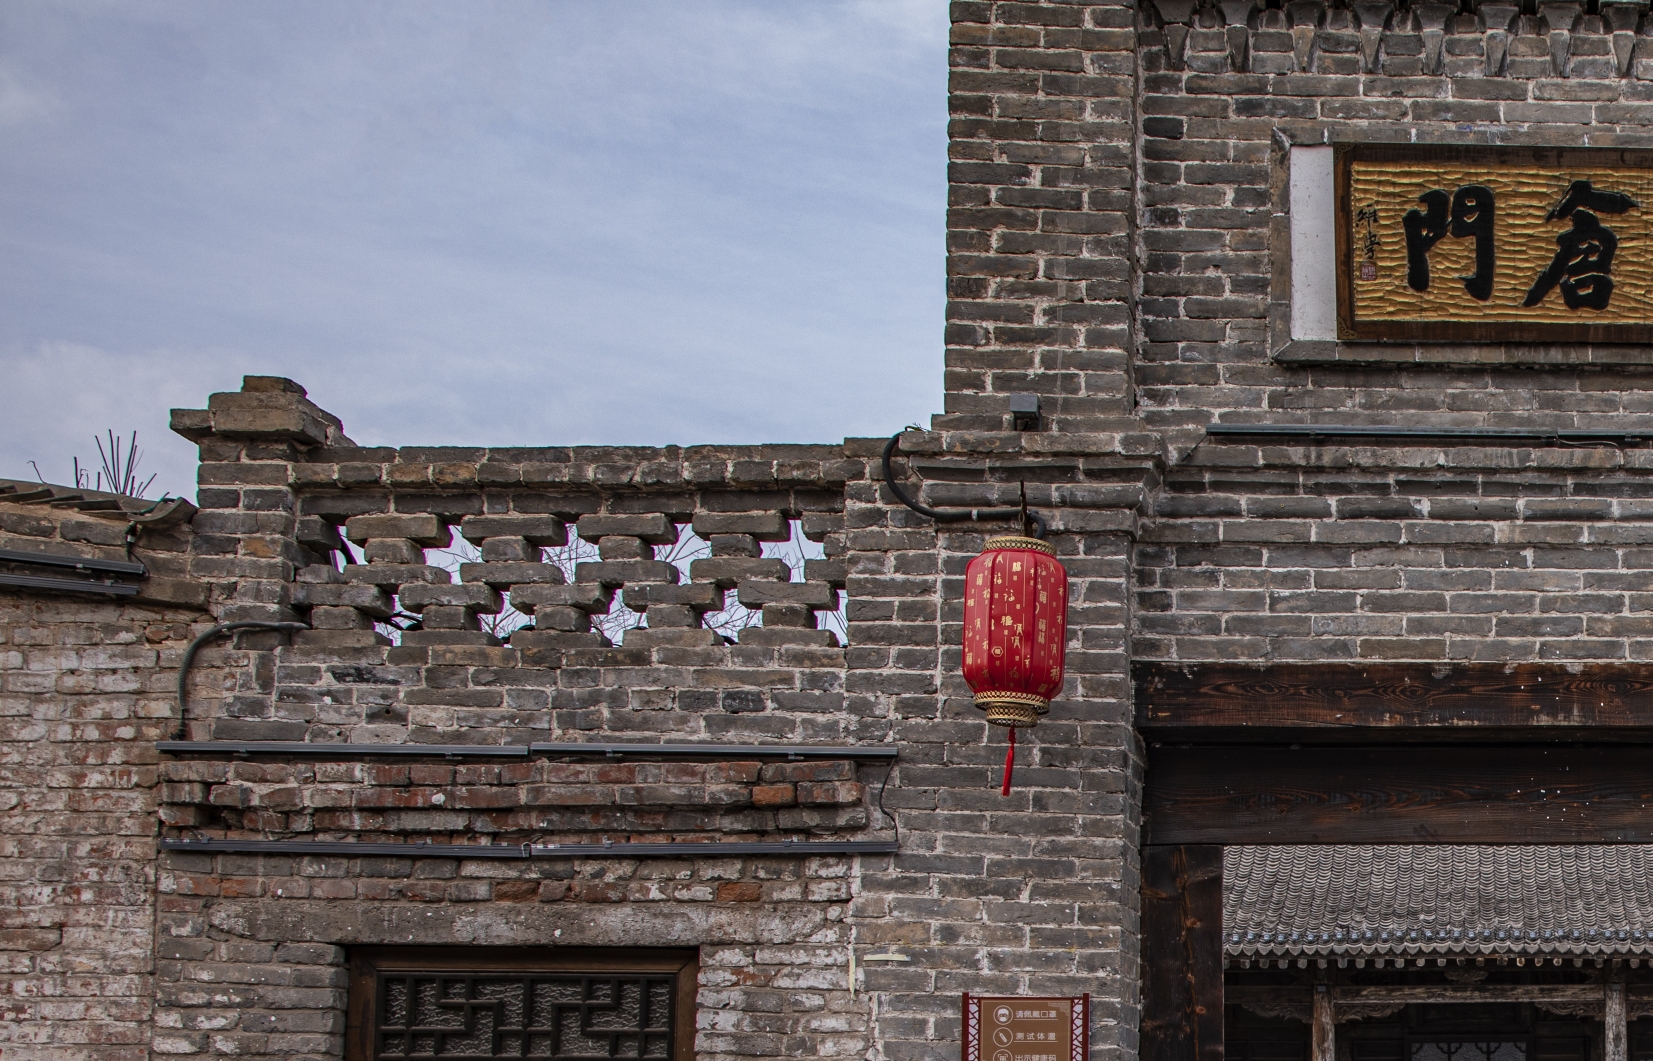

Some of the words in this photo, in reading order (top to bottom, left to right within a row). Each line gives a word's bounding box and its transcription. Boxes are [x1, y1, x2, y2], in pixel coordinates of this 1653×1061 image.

[1015, 1010, 1057, 1018] 请佩戴口罩
